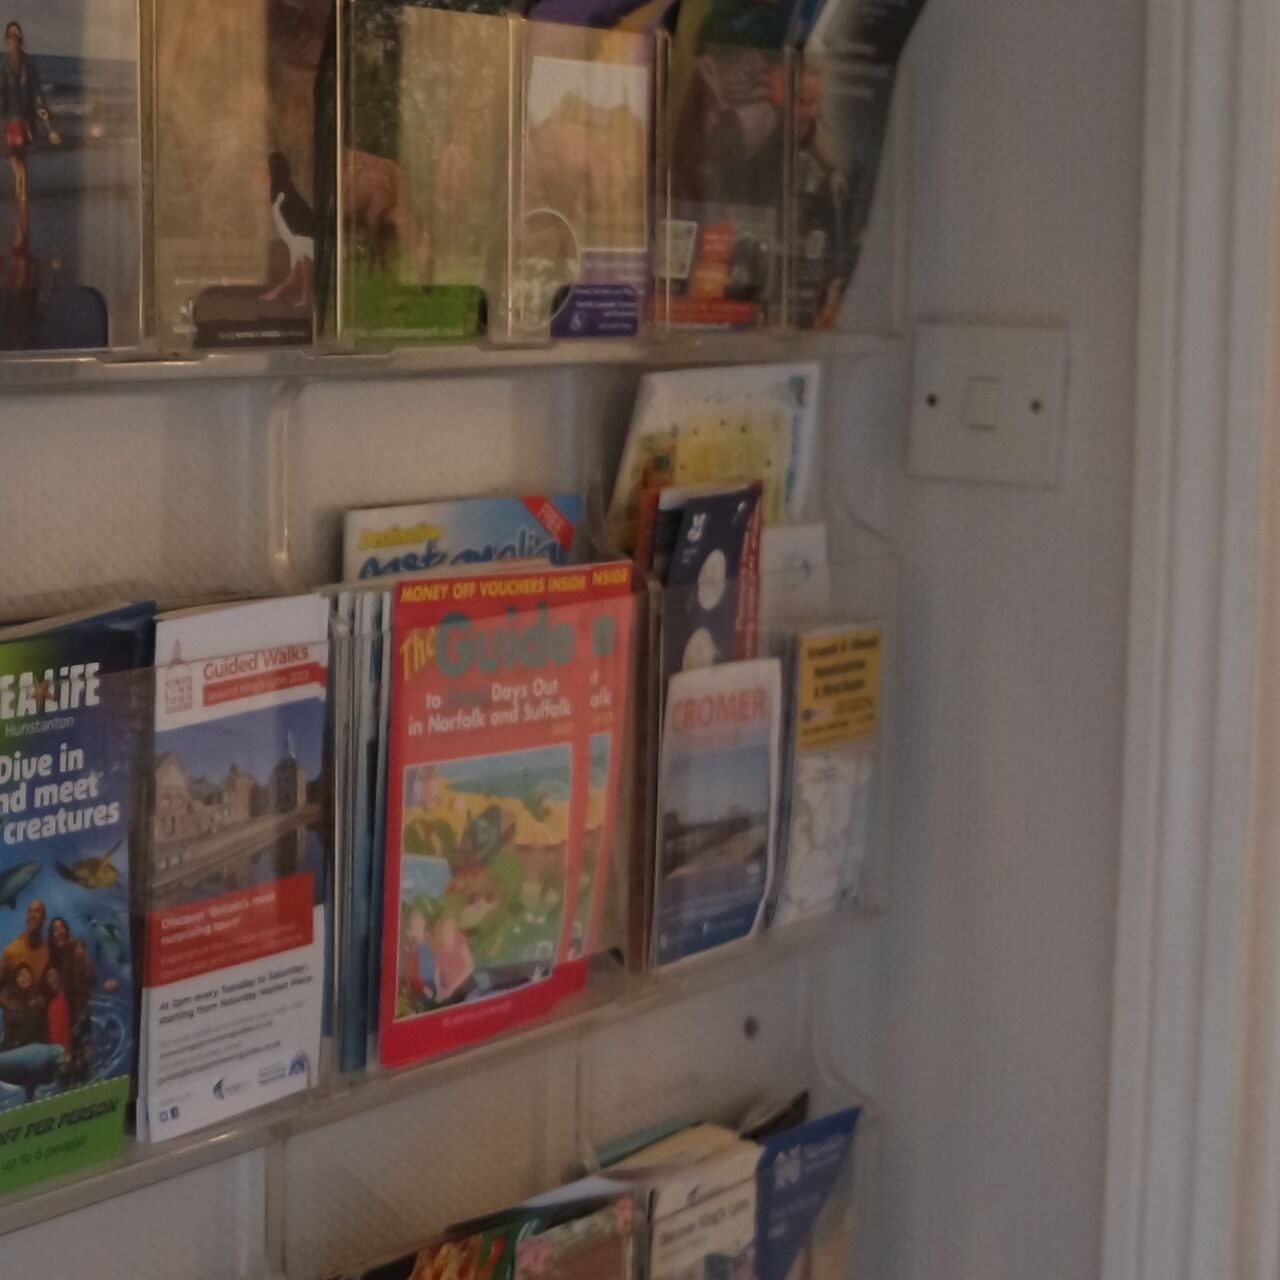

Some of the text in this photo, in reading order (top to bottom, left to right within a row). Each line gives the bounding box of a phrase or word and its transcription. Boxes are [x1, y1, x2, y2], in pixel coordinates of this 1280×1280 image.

[400, 575, 586, 603] MONEY OFF VOUCHERS INSIDE
[592, 568, 628, 585] NSIDE
[400, 626, 437, 683] The
[436, 602, 575, 678] Guide
[202, 645, 310, 681] Guided Walks
[426, 692, 442, 709] to
[491, 681, 527, 707] Days
[532, 676, 559, 696] Out
[408, 697, 572, 736] in Norfolk and Suffolk
[671, 686, 768, 730] CROMER
[4, 716, 75, 738] Hunstanton
[59, 742, 84, 773] in
[33, 773, 100, 809] meet
[2, 801, 121, 846] creatures
[194, 989, 219, 1003] every
[158, 1009, 195, 1025] starting
[196, 1002, 218, 1014] from
[24, 1115, 56, 1139] PER
[57, 1098, 119, 1128] PERSON
